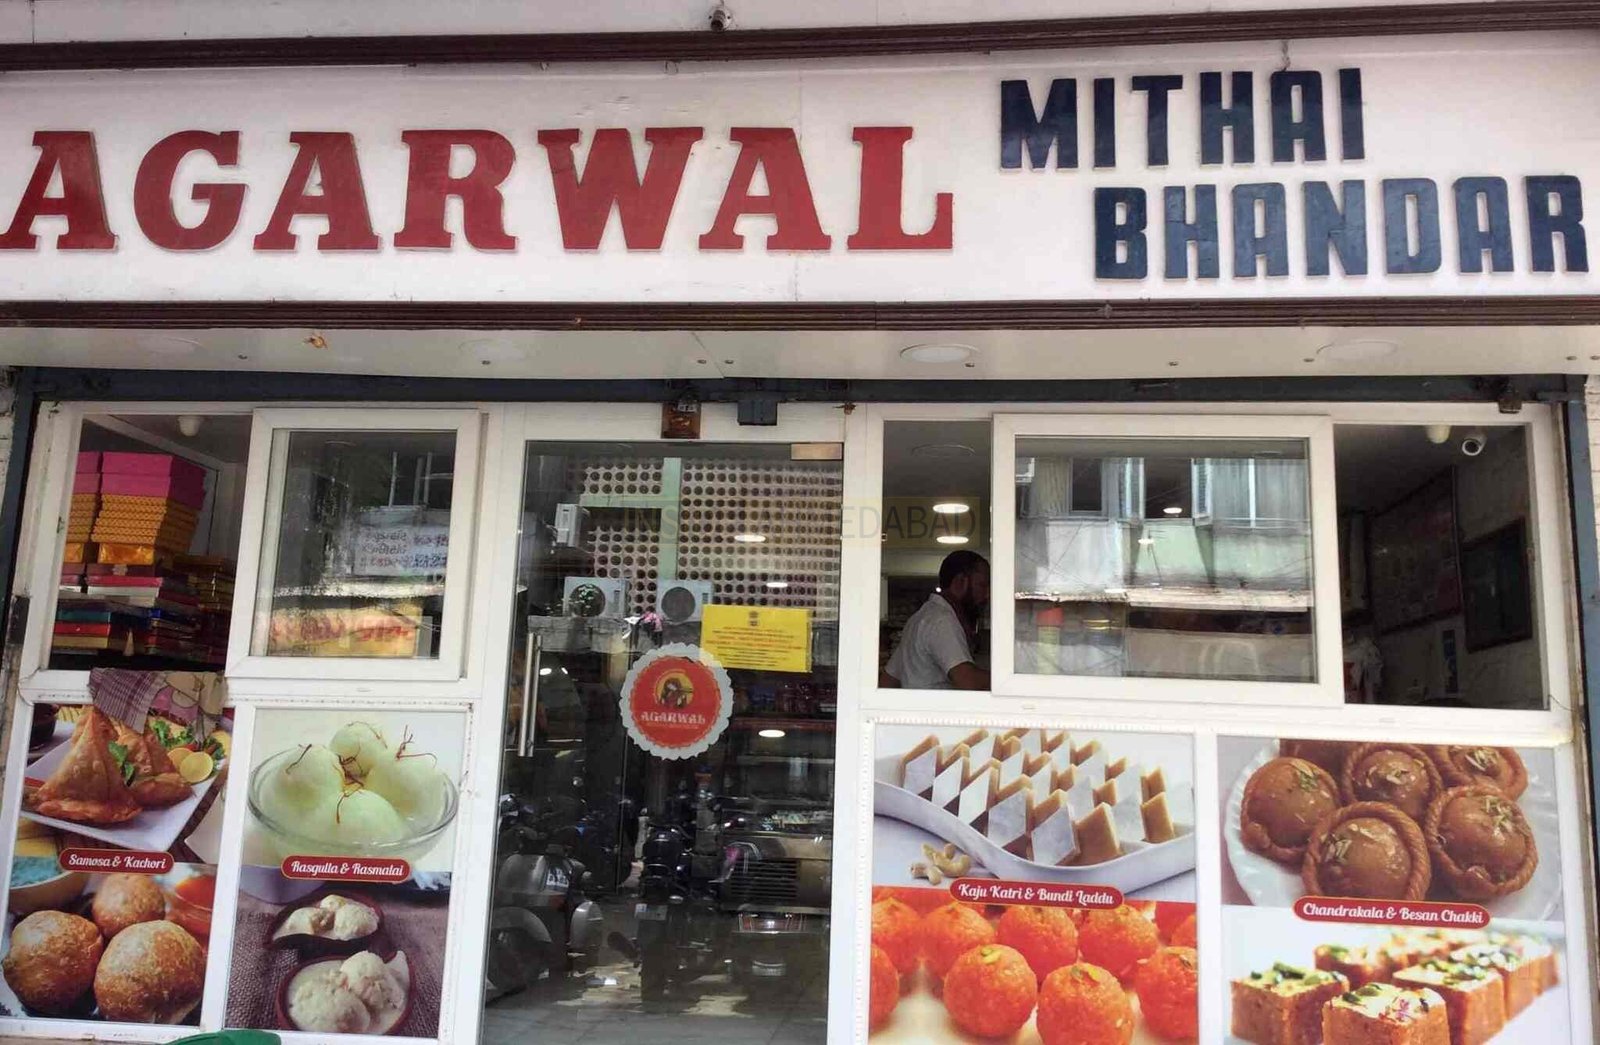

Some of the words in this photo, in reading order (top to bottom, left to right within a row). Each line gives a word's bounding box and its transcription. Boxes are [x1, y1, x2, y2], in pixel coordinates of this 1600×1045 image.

[1000, 68, 1365, 170] MITHAI
[0, 126, 953, 252] AGARWAL
[1094, 175, 1588, 281] BHANDAR
[640, 711, 706, 725] AGARWAL
[68, 854, 111, 868] Samosa
[112, 855, 122, 867] &
[124, 856, 167, 869] Kachori
[291, 860, 339, 876] Rasgulla
[340, 862, 350, 875] &
[352, 863, 403, 876] Rasmalai
[958, 883, 988, 901] Kaju
[989, 884, 1022, 899] Katri
[1024, 887, 1035, 900] &
[1037, 887, 1074, 903] Bundi
[1075, 890, 1114, 906] Laddu
[1303, 902, 1384, 919] Chandrakala
[1386, 907, 1397, 920] &
[1399, 909, 1439, 922] Besan
[1440, 909, 1484, 924] Chakki
